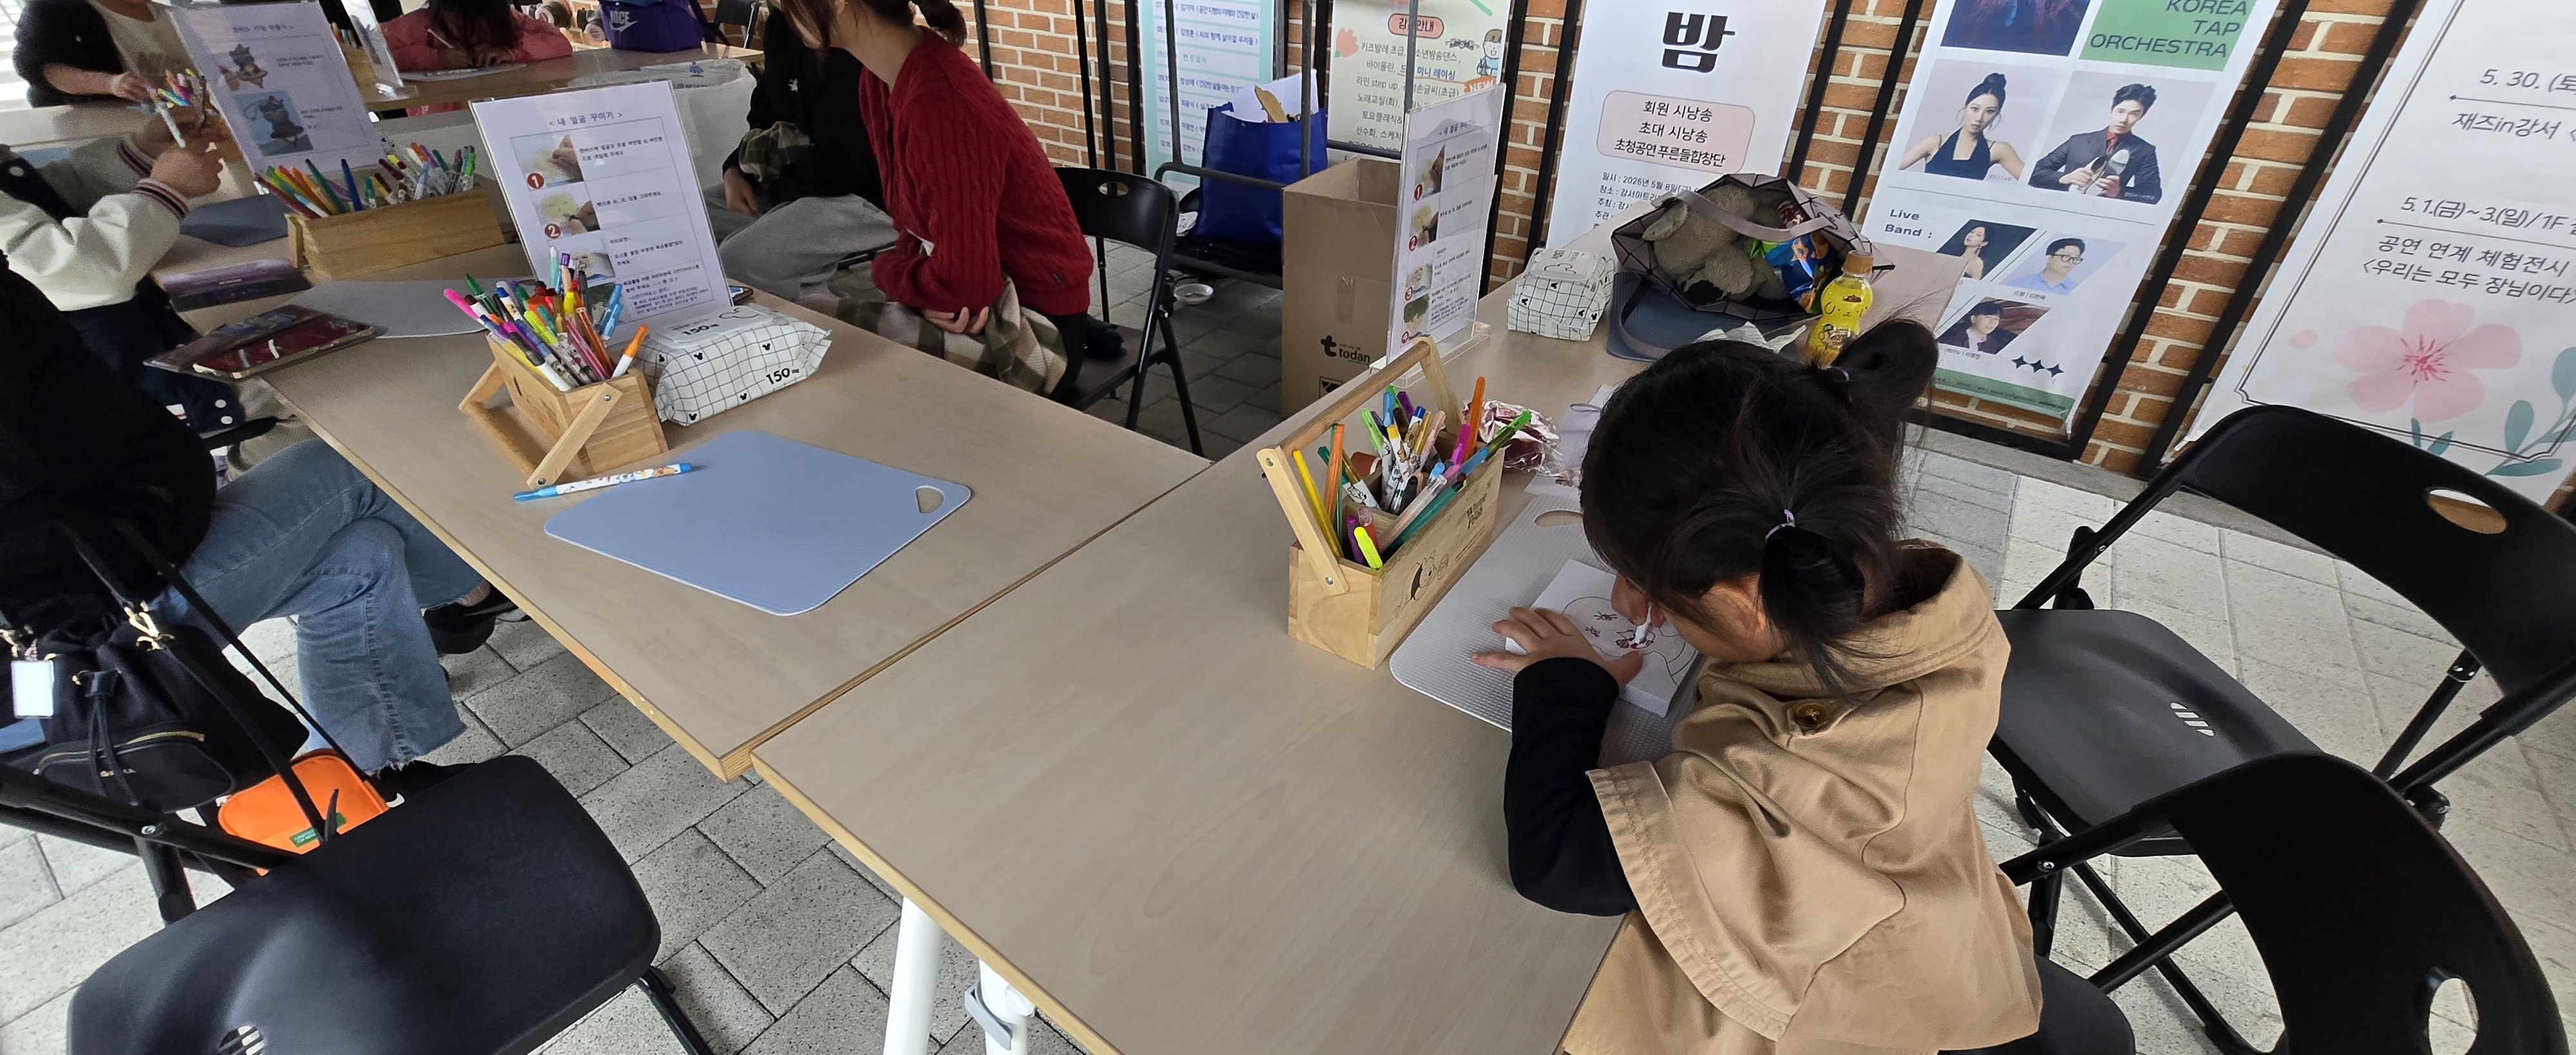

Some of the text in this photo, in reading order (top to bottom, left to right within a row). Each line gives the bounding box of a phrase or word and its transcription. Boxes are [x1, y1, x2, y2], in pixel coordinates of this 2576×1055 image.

[2166, 0, 2247, 15] KOREA
[2193, 20, 2240, 36] TAP
[1662, 12, 1736, 73] 밤
[2090, 34, 2226, 57] ORCHESTRA
[1361, 42, 1389, 55] 키즈발레
[1412, 49, 1461, 64] 소년방송댄스,
[1367, 61, 1396, 73] 바이올린,
[1417, 67, 1431, 77] 미니
[1434, 68, 1456, 81] 레이싱
[2479, 68, 2498, 86] 5.
[2506, 71, 2539, 89] 30.
[1356, 76, 1370, 88] 라인
[1371, 79, 1387, 90] step
[557, 118, 565, 126] 내
[569, 115, 586, 124] 얼굴
[590, 112, 614, 122] 꾸미기
[1643, 100, 1713, 122] 회원 시낭송
[1639, 122, 1708, 144] 초대 시낭송
[2452, 113, 2562, 140] 재즈in강서
[1614, 139, 1726, 167] 초청공연 푸른들합창단
[1600, 185, 1614, 195] 장소
[1603, 172, 1617, 182] 일시
[1623, 176, 1649, 187] 2026년
[1651, 180, 1663, 190] 5월
[1598, 198, 1612, 207] 주최
[1595, 211, 1609, 220] 주관
[1889, 209, 1920, 220] Live
[1884, 224, 1922, 236] Band
[2378, 235, 2570, 277] 공연 연계 체험전시
[2436, 271, 2480, 289] 모두
[1339, 348, 1370, 363] todan
